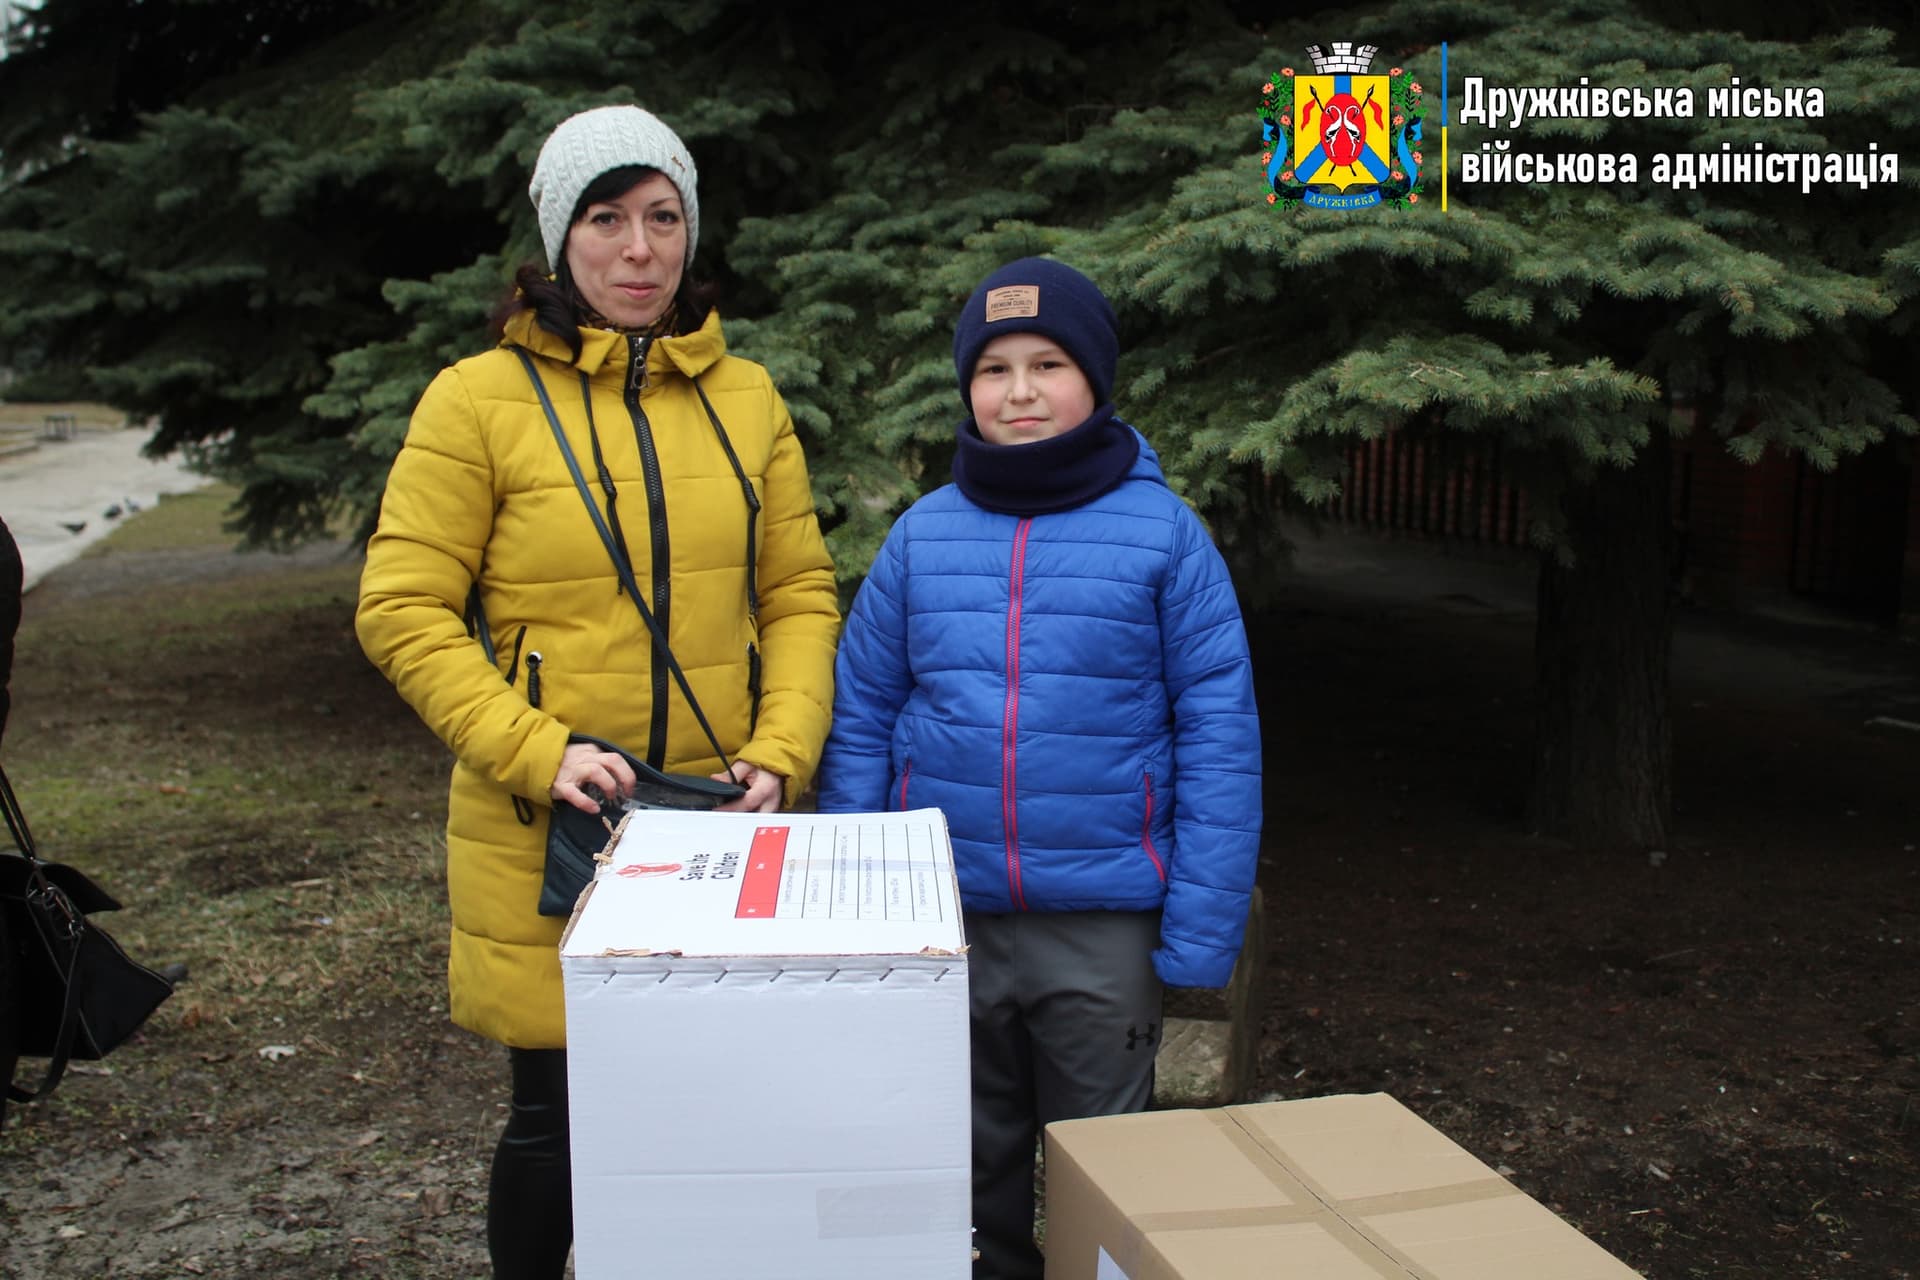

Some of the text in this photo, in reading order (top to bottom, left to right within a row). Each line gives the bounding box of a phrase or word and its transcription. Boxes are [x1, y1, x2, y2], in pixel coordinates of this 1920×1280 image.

[679, 853, 710, 880] Save the
[710, 851, 741, 879] Children
